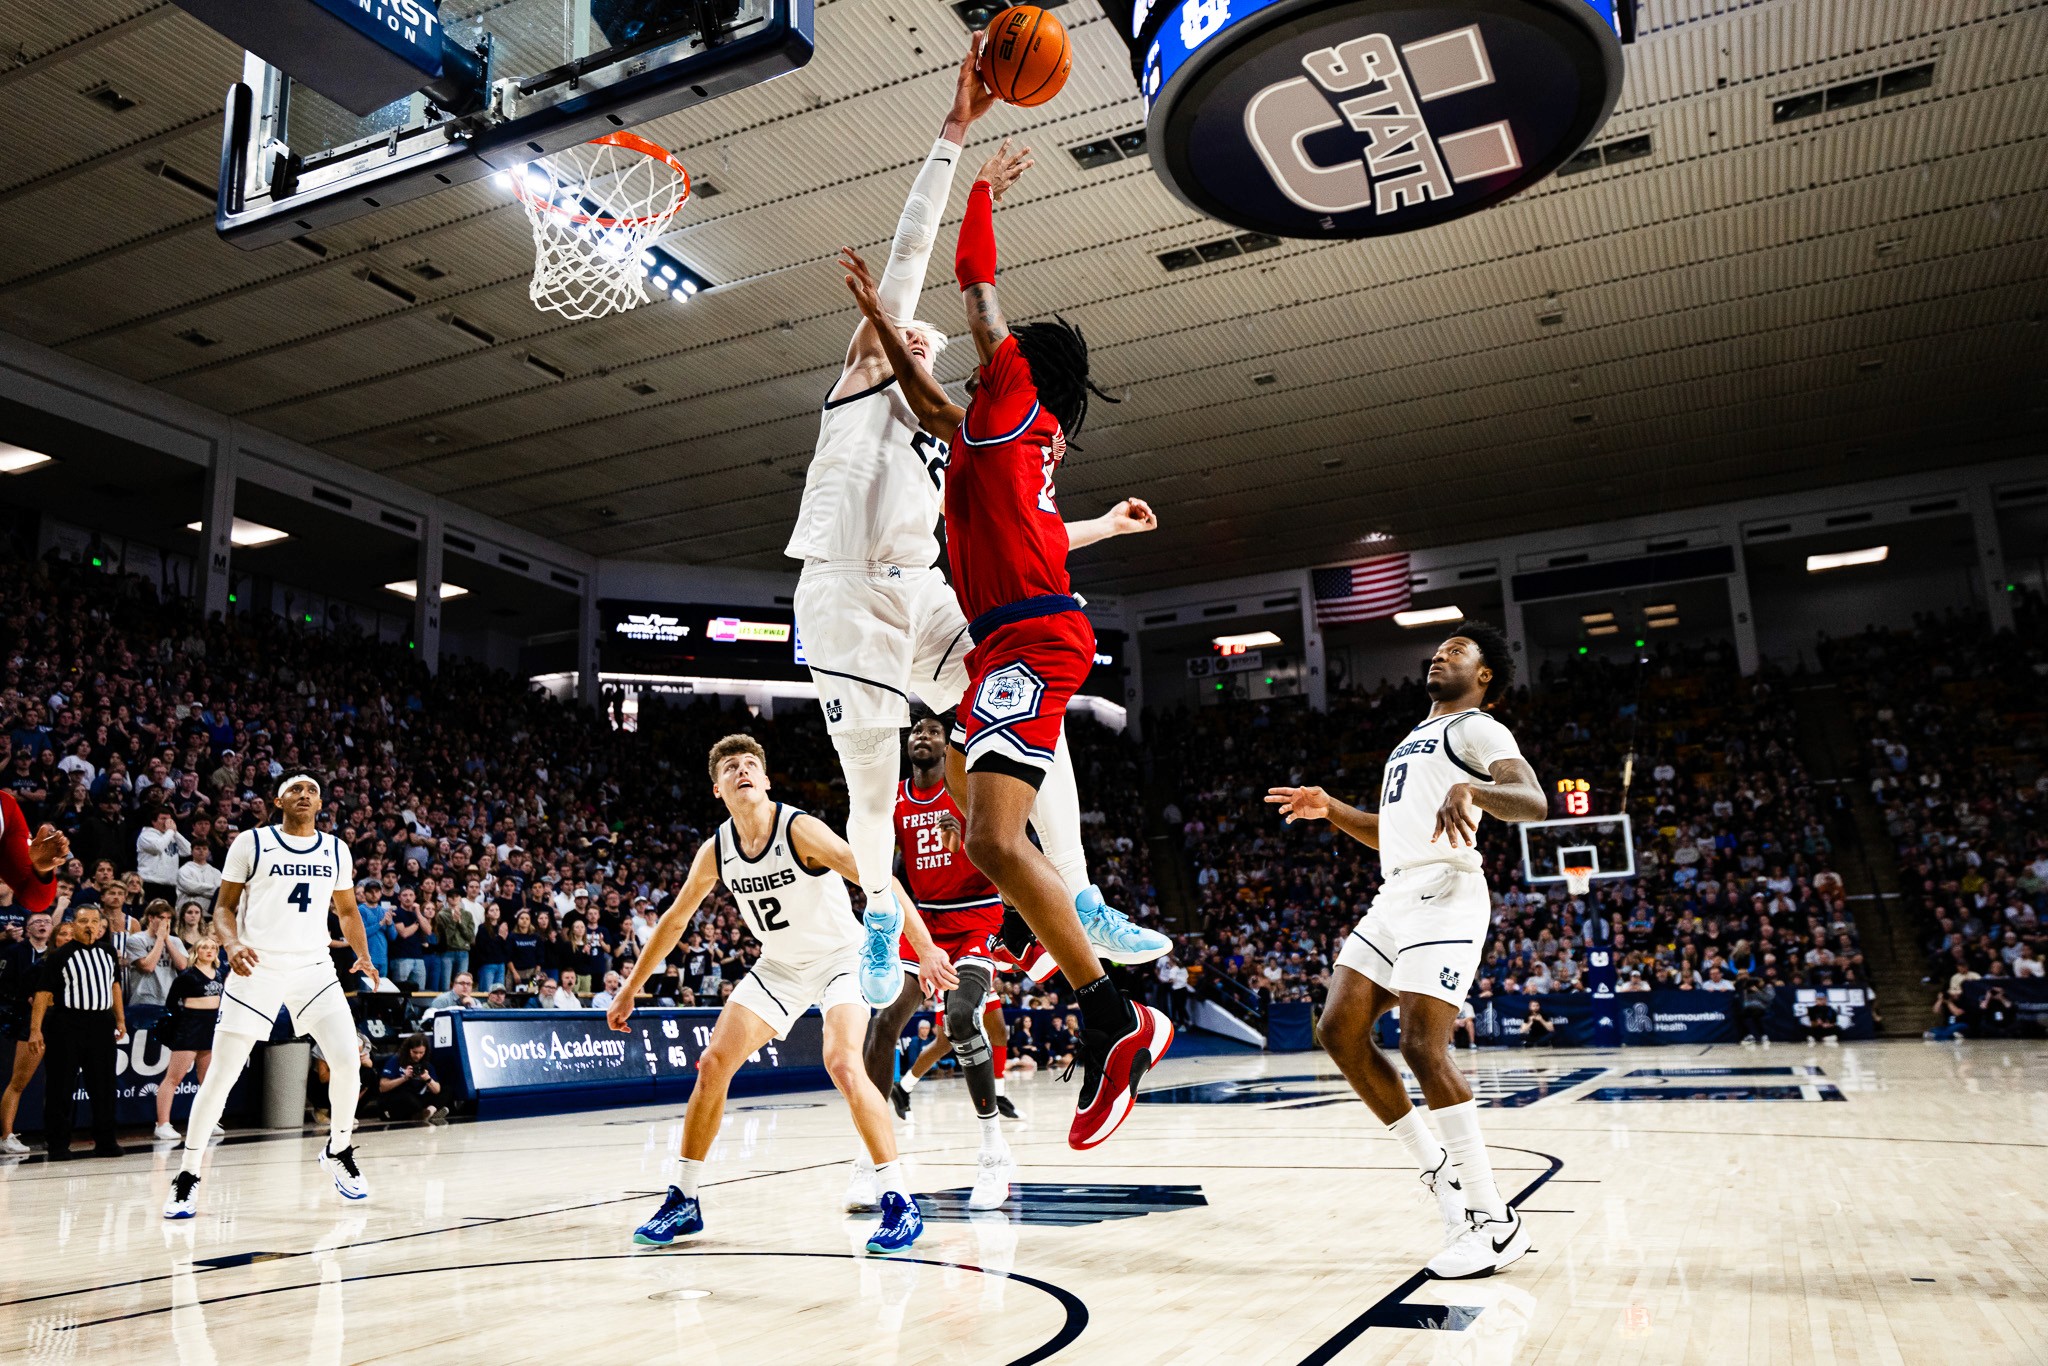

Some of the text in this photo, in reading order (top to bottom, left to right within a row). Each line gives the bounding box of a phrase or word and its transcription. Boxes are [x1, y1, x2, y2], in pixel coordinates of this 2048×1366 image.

[1302, 33, 1454, 215] STATE
[1318, 216, 1336, 230] TM
[1381, 762, 1408, 807] 13
[1566, 791, 1589, 815] 13
[916, 828, 944, 854] 23
[269, 863, 332, 878] AGGIES
[915, 853, 952, 870] STATE
[731, 868, 796, 894] AGGIES
[287, 882, 312, 913] 4
[747, 896, 791, 932] 12
[1653, 1011, 1726, 1022] Intermountain
[1654, 1022, 1688, 1032] Health
[480, 1034, 547, 1068] Sports
[549, 1031, 625, 1062] Academy
[668, 1046, 687, 1067] 45
[124, 1086, 136, 1098] of
